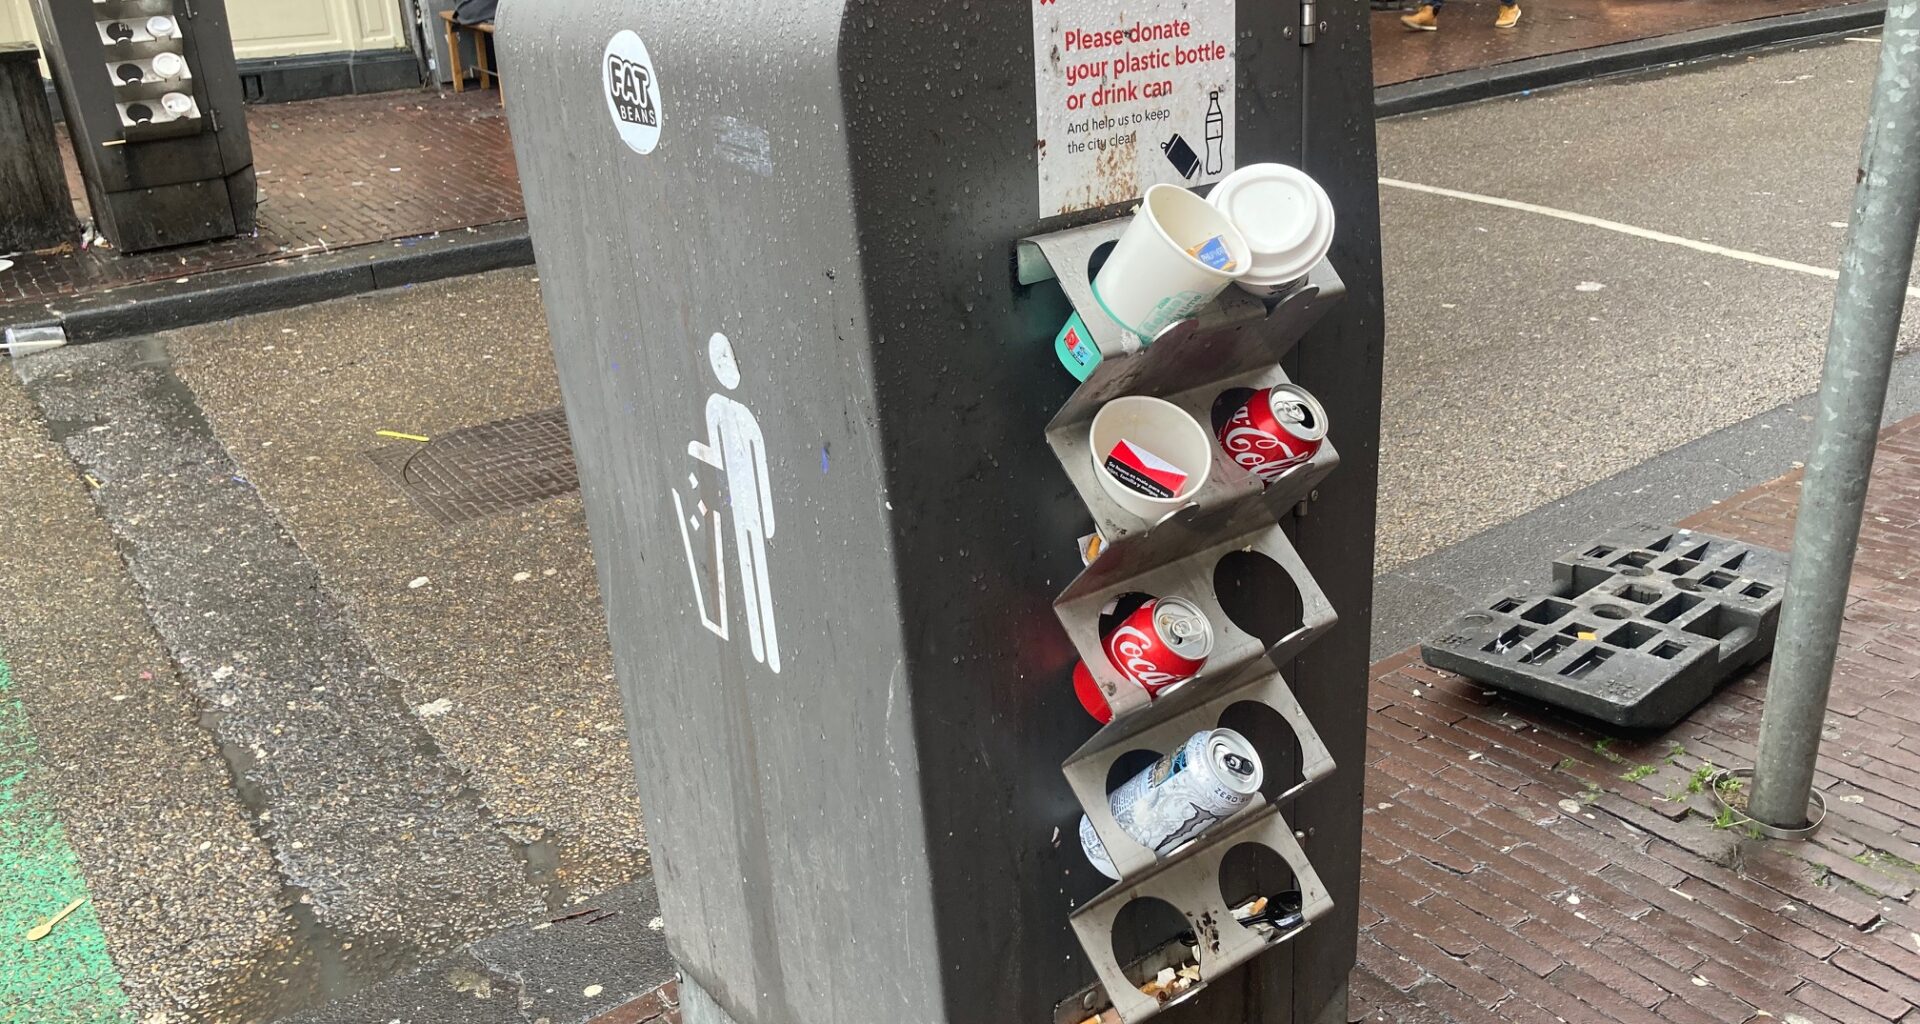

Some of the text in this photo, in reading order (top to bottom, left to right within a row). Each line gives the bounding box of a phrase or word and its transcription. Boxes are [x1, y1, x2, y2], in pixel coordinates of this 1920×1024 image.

[1065, 19, 1190, 52] Please donate
[1066, 40, 1226, 86] your plastic bottle
[608, 54, 650, 108] FAT
[1066, 80, 1172, 110] or drink can
[620, 105, 656, 125] BEANS
[1067, 109, 1170, 135] And help us to keep
[1067, 131, 1137, 154] the city clean
[1214, 786, 1239, 803] ZERO
